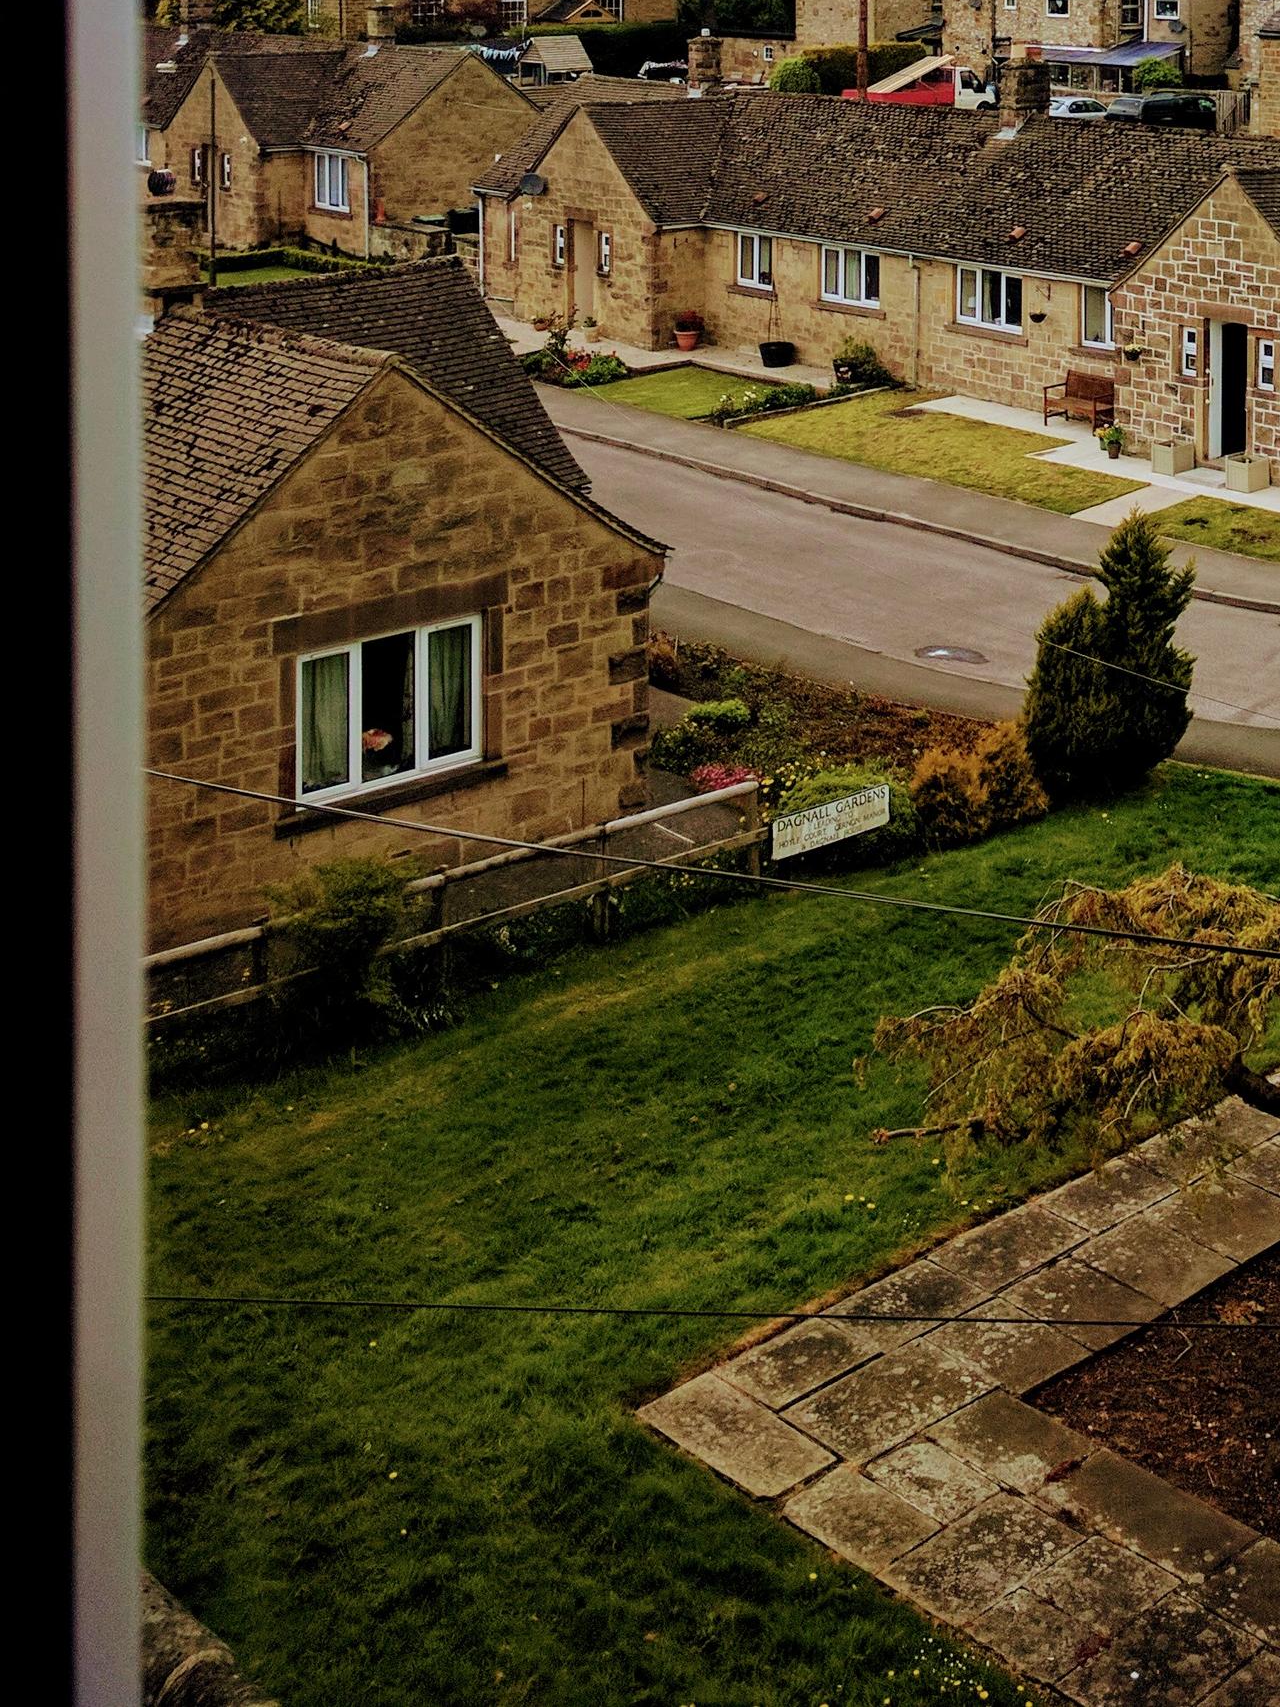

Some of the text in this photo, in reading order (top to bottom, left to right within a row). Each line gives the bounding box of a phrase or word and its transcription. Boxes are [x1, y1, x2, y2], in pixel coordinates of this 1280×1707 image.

[777, 787, 886, 832] DAGNALL GARDENS
[803, 828, 827, 842] COURT
